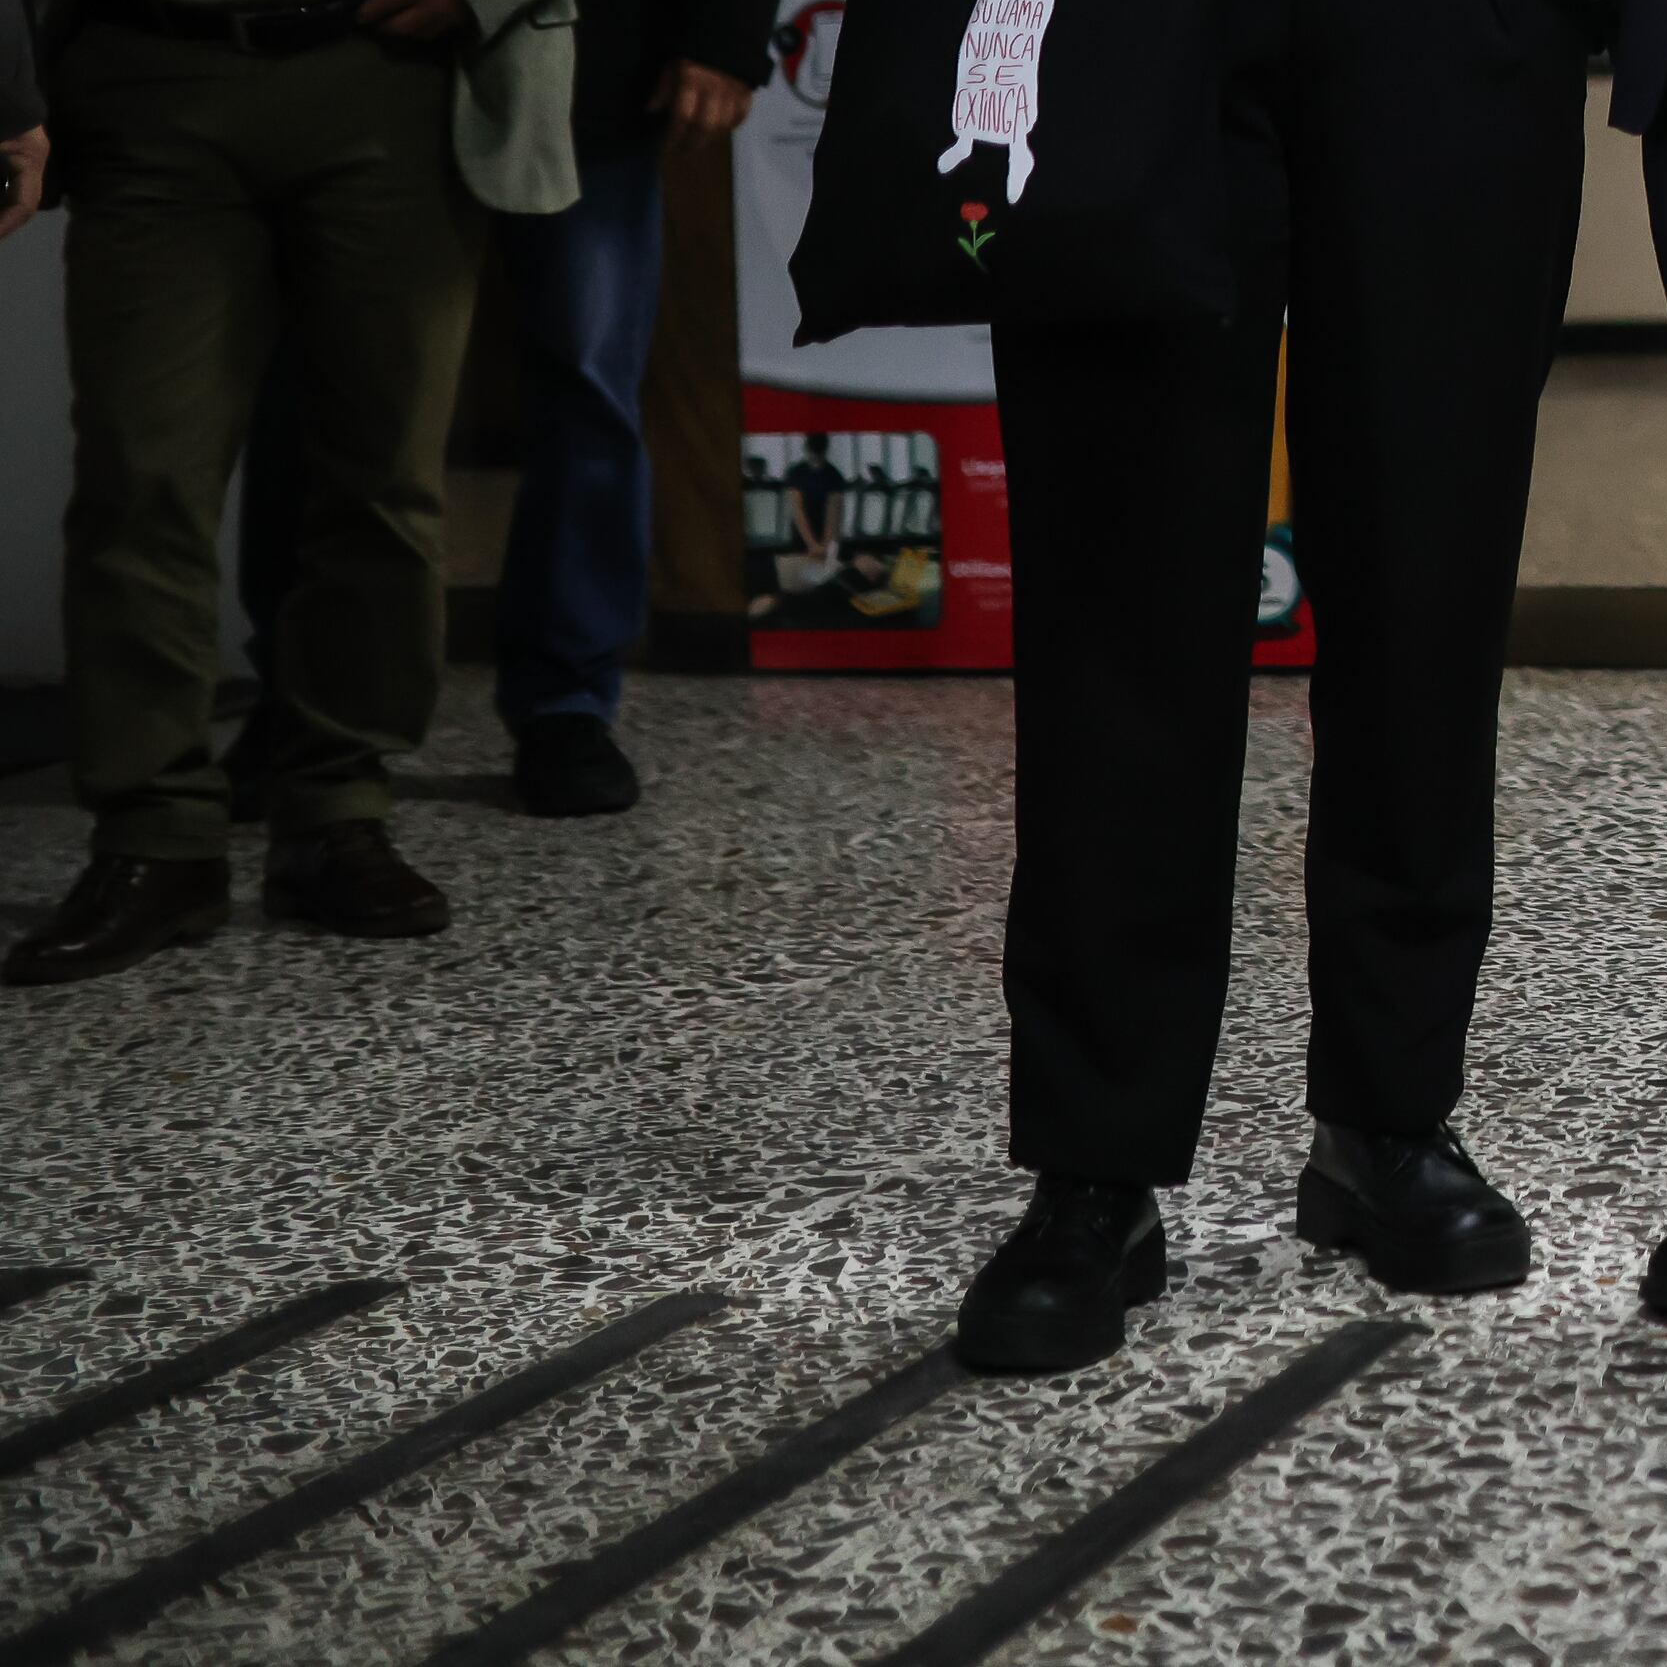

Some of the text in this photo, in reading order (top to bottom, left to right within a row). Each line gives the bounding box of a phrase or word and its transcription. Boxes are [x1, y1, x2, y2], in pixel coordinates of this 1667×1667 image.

[996, 0, 1043, 29] LLAMA
[965, 33, 1034, 61] NUNCA
[966, 64, 1023, 85] SE
